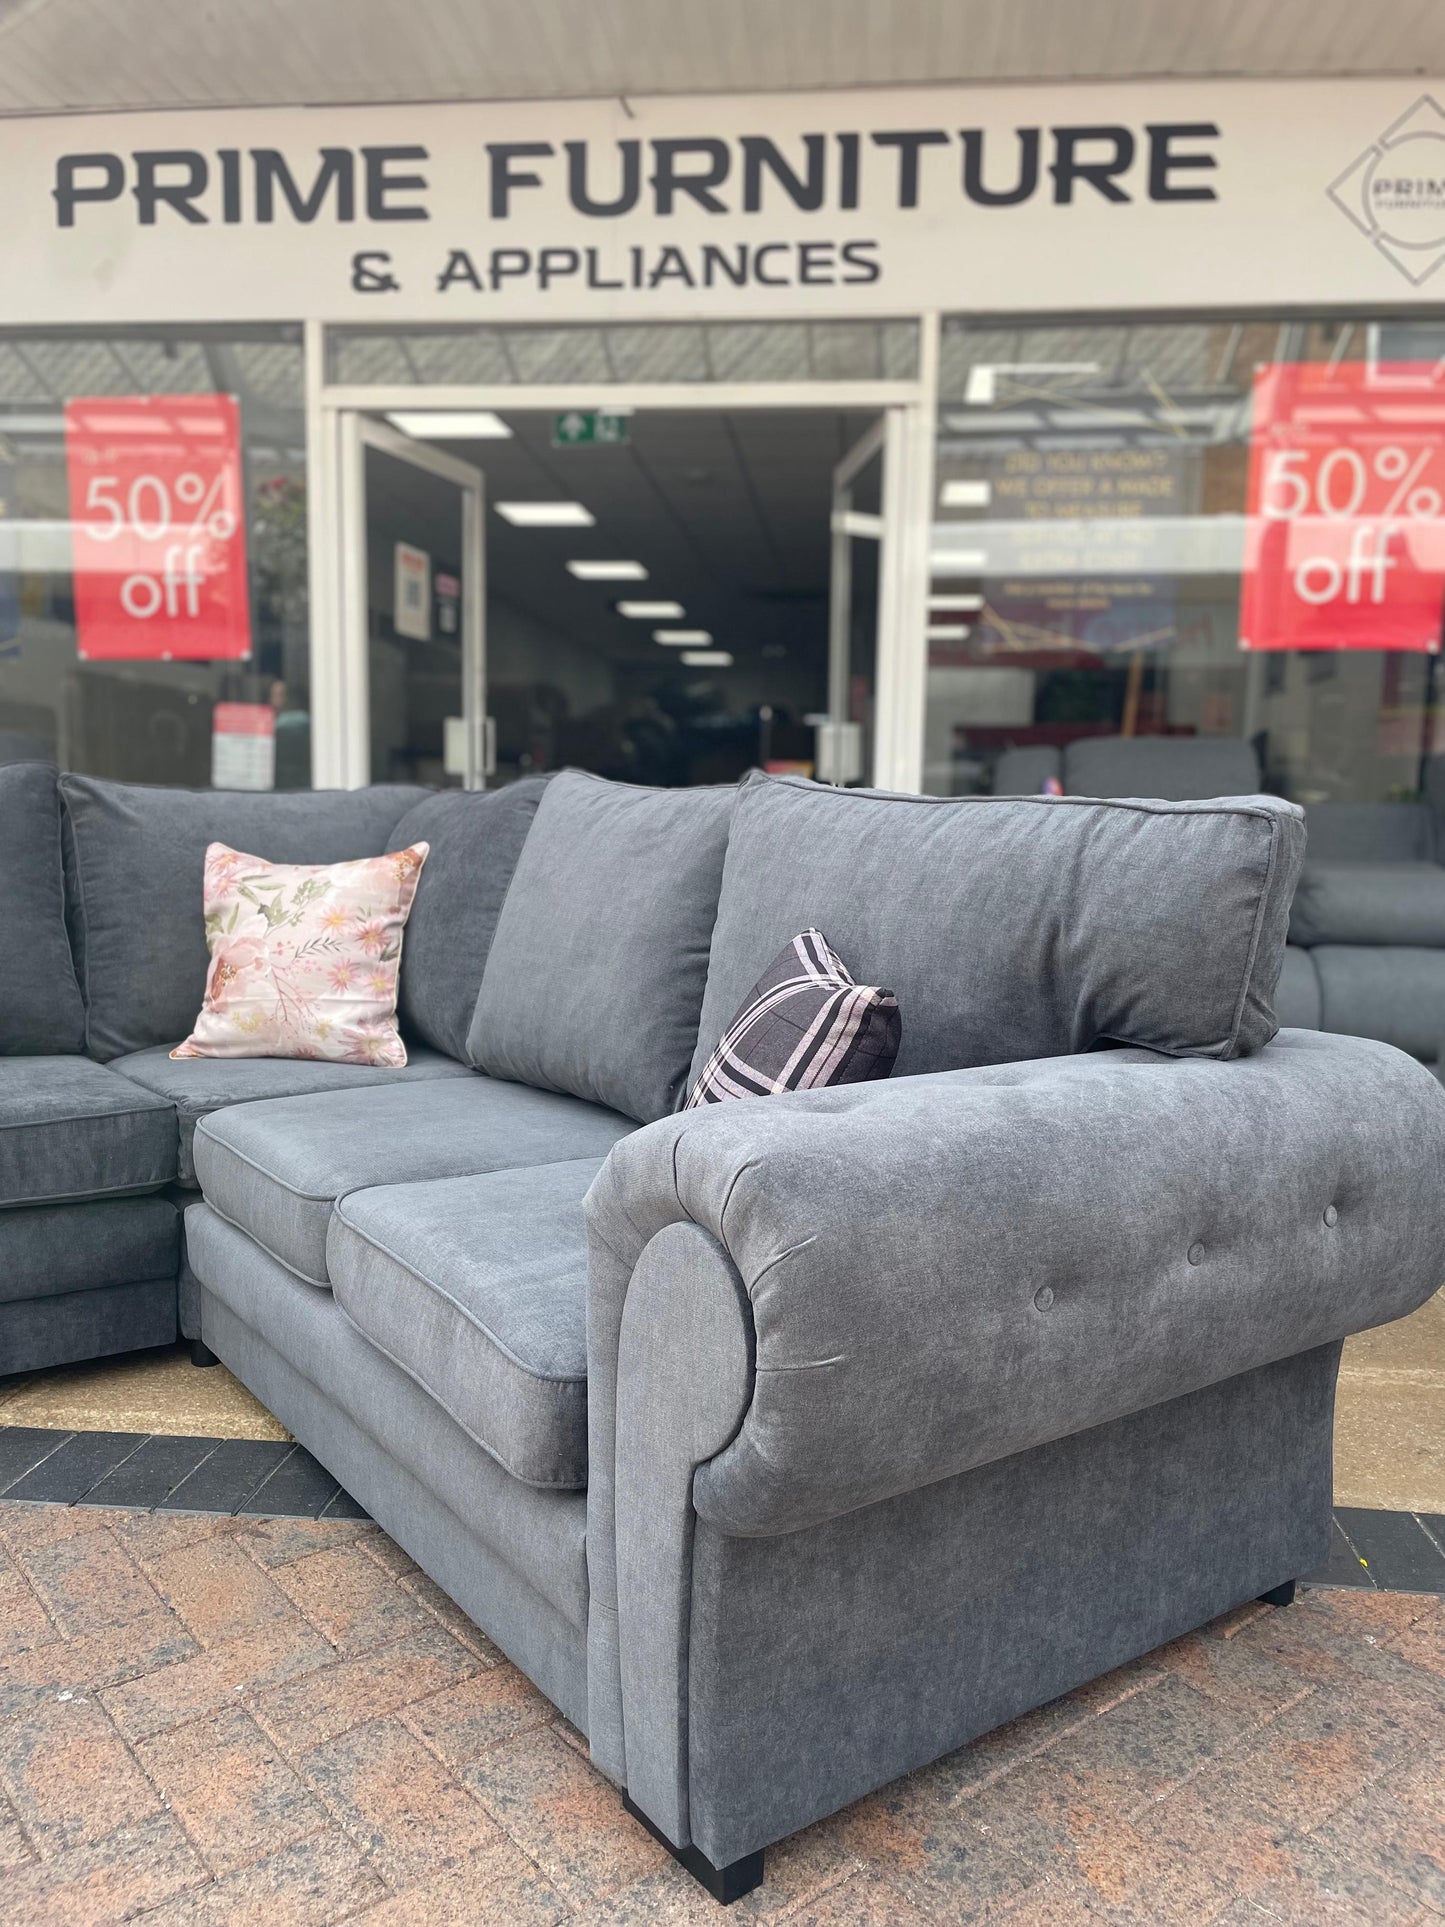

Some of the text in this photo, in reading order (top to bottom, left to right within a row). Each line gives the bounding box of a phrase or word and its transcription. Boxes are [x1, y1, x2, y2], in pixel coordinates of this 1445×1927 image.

[52, 122, 1221, 228] PRIME FURNITURE
[351, 240, 882, 293] & APPLIANCES
[85, 472, 237, 542] 50%
[1261, 447, 1441, 520] 50%
[120, 544, 206, 618] off
[1293, 523, 1397, 605] off
